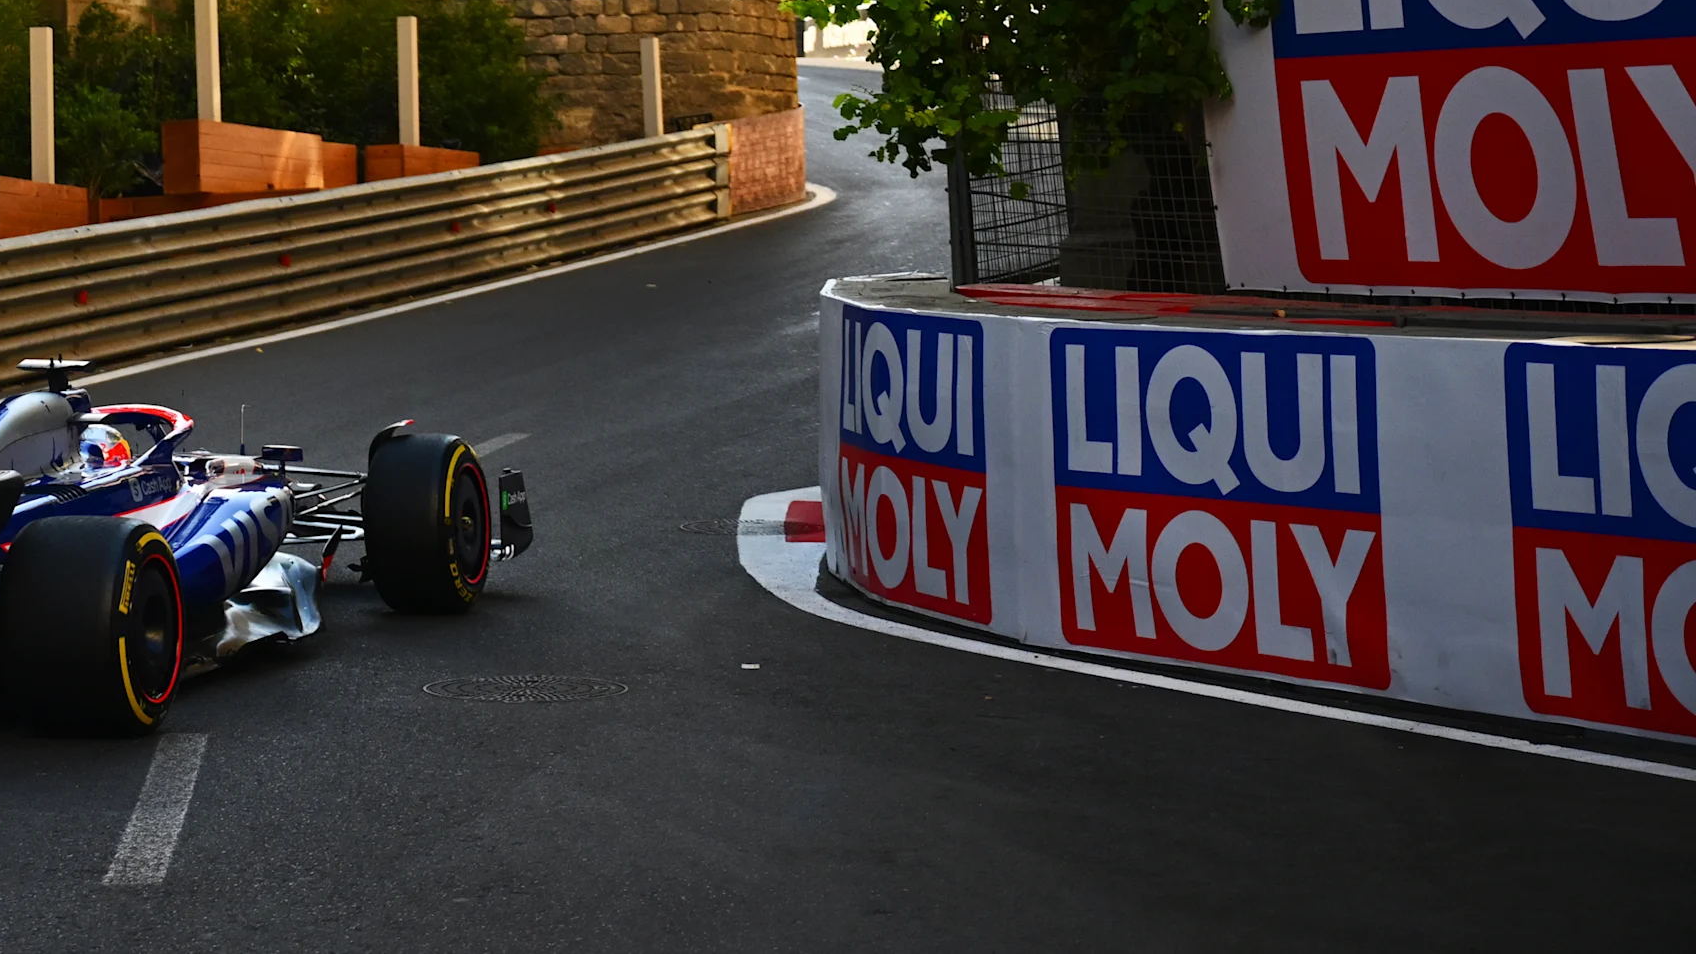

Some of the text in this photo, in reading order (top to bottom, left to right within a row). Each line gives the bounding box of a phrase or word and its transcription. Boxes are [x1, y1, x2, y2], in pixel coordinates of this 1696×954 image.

[843, 318, 975, 457] LIQUI
[1064, 343, 1361, 495] LIQUI
[841, 457, 984, 606] MOLY
[1068, 502, 1375, 668] MOLY
